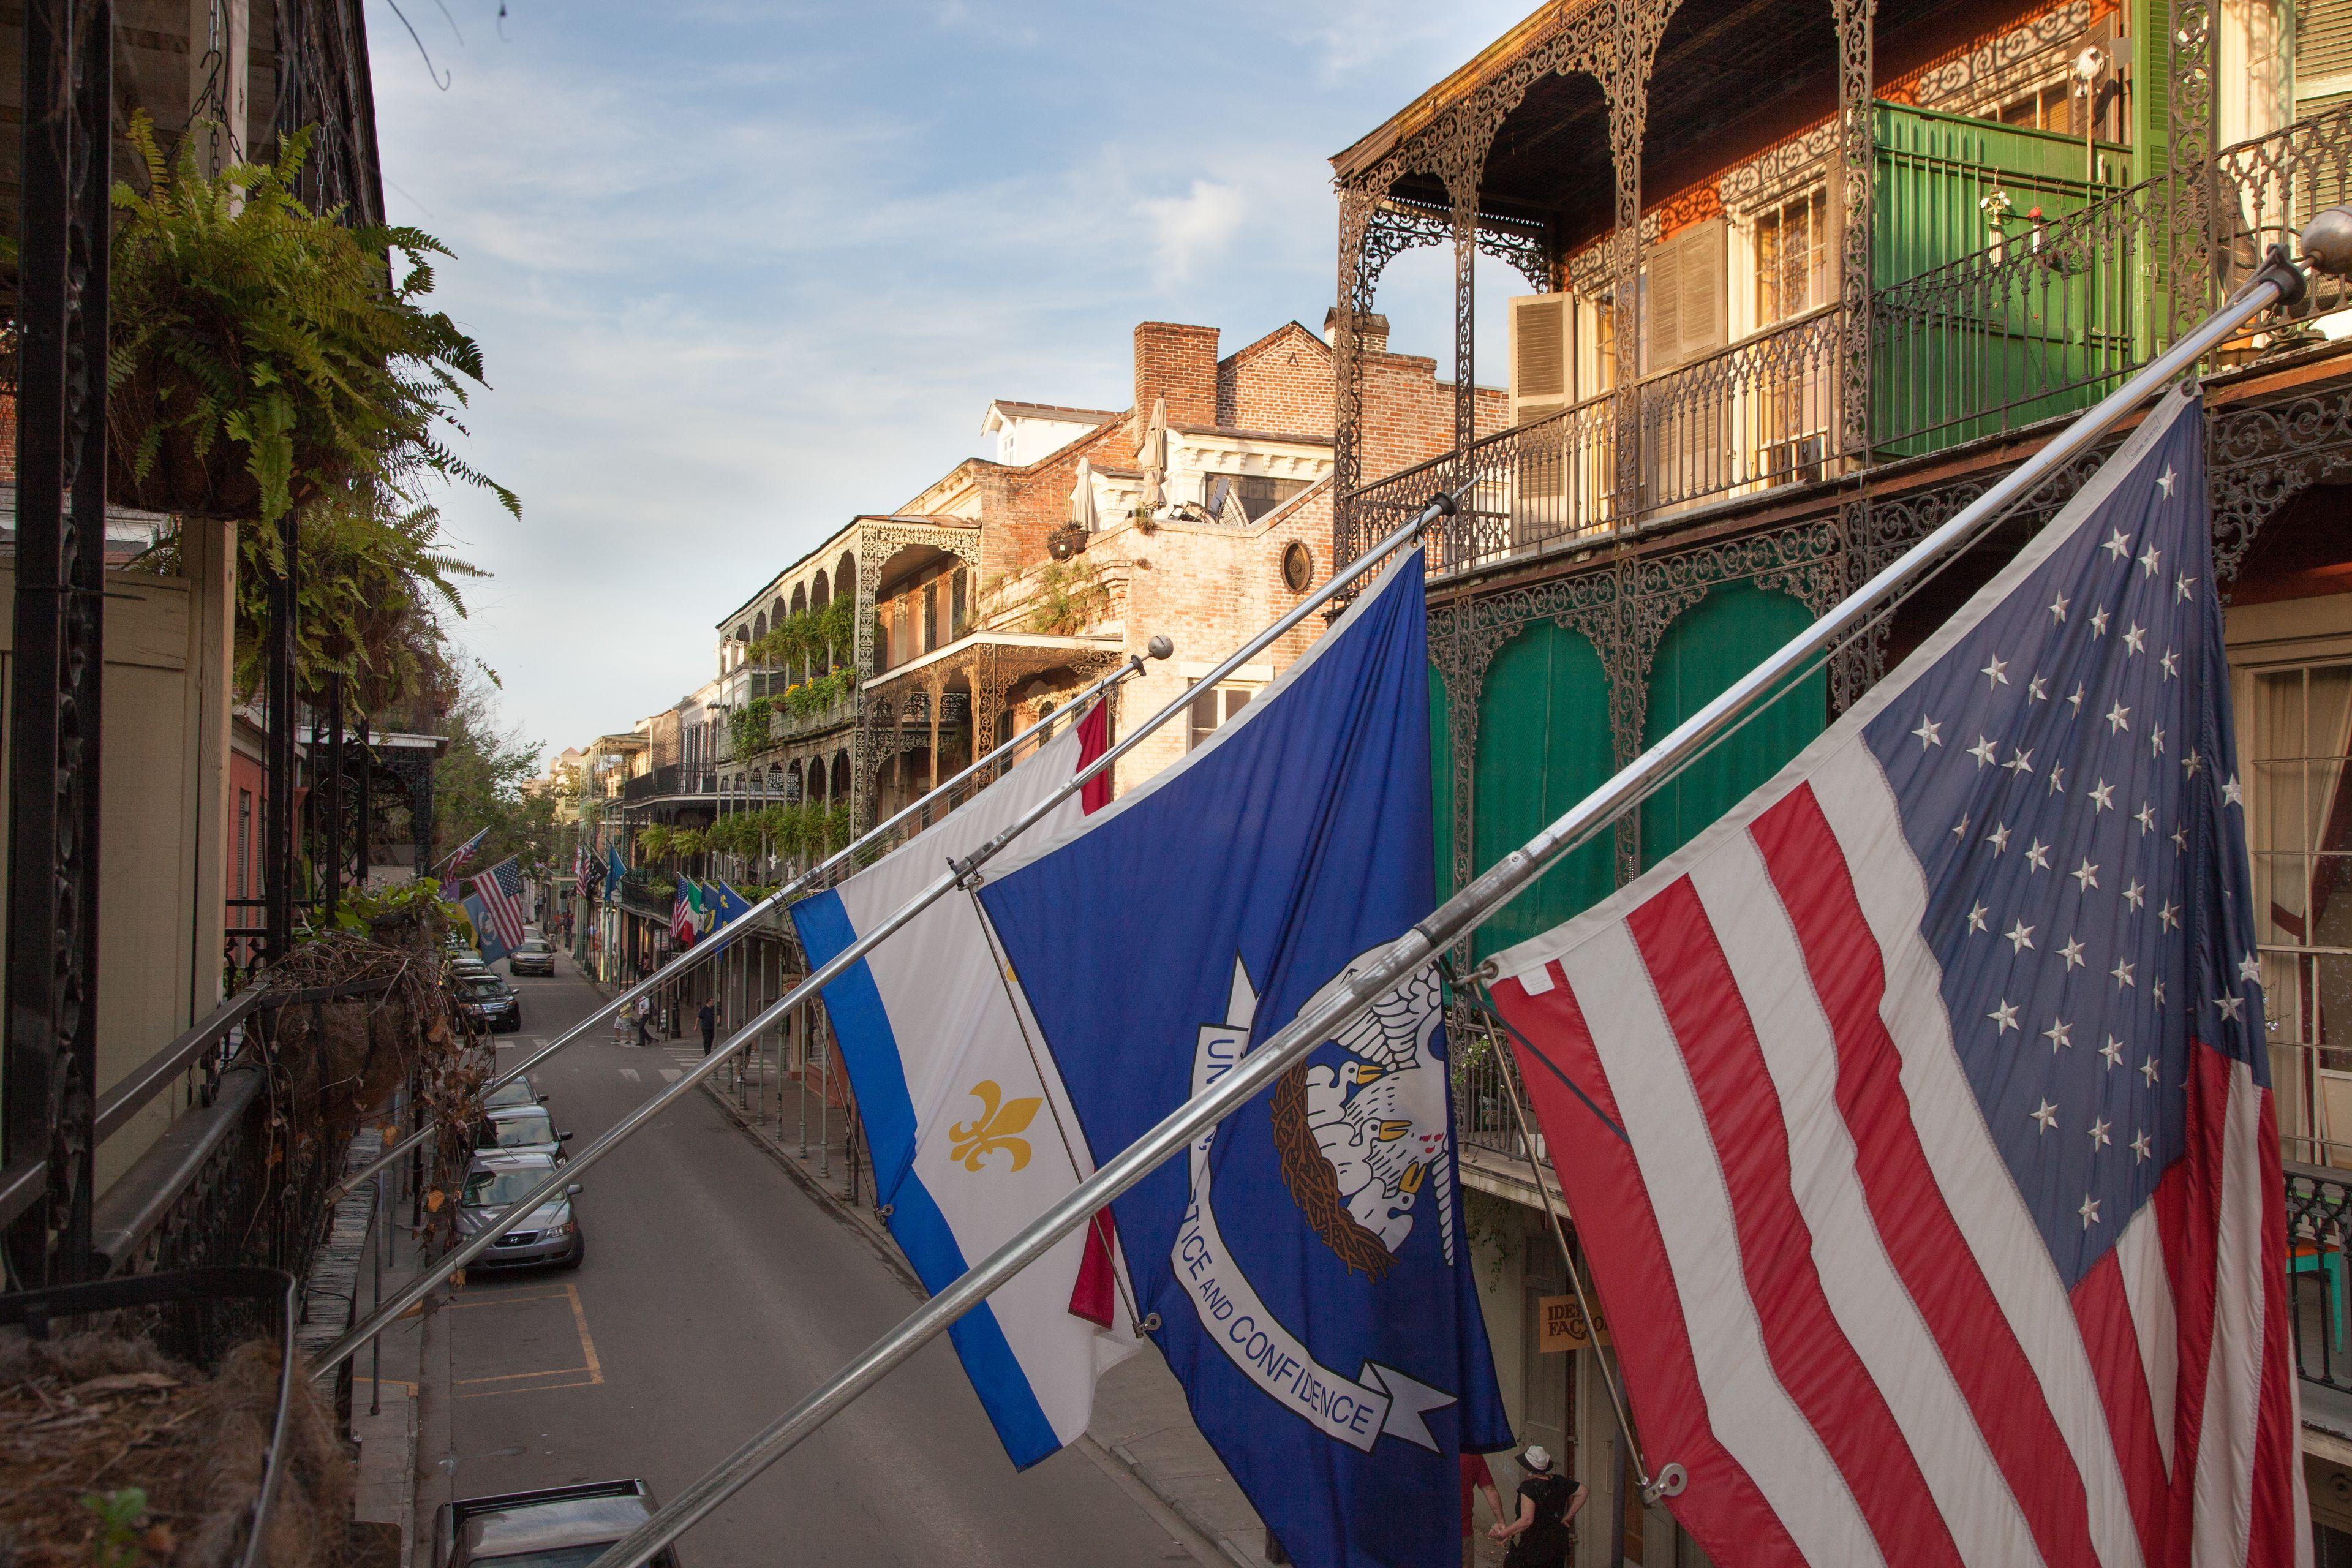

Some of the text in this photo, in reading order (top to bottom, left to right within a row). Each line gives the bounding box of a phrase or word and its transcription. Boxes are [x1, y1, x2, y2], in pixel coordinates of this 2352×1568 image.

[1199, 1278, 1234, 1321] AND
[1229, 1316, 1374, 1434] CONFIDENCE
[1548, 1316, 1608, 1340] FACO
